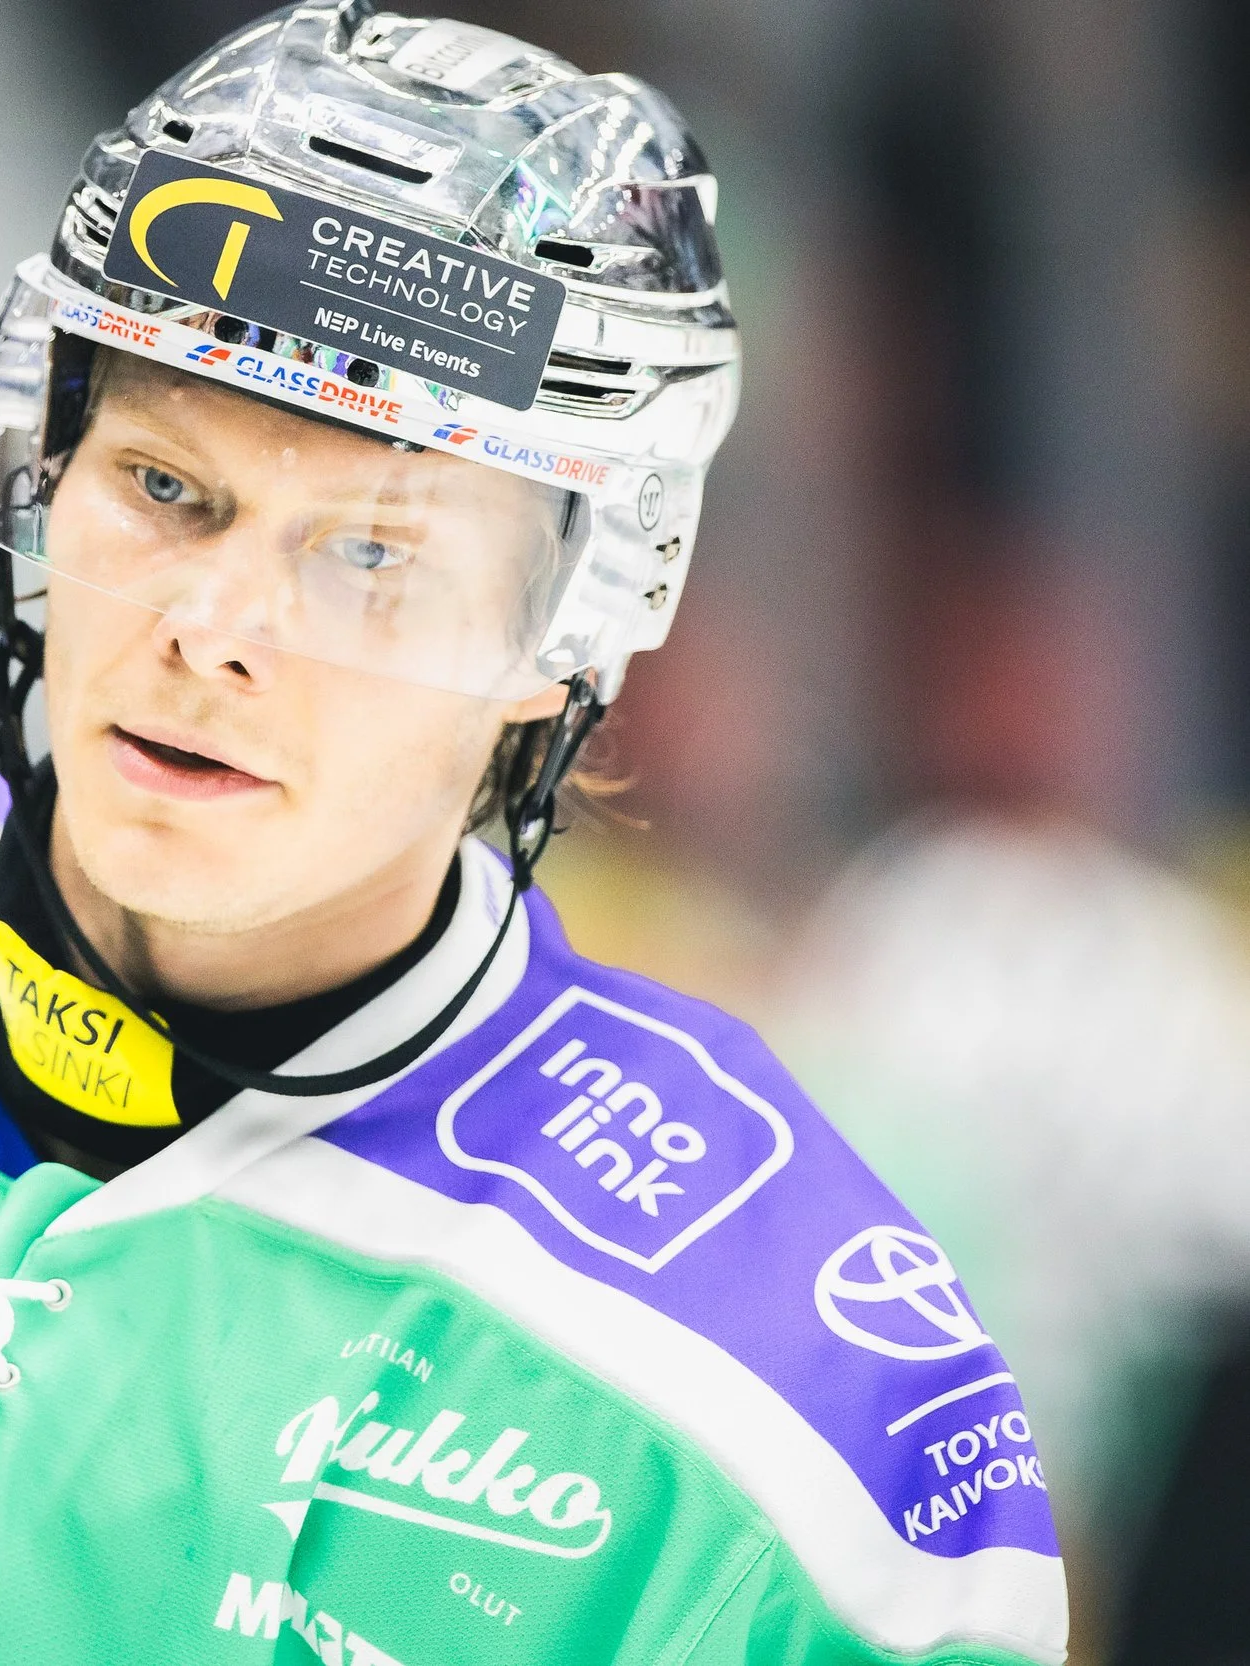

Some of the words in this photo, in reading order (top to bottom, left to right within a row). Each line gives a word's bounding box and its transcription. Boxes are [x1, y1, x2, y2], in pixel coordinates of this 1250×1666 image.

[307, 248, 528, 337] TECHNOLOGY
[312, 216, 536, 312] CREATIVE
[313, 307, 360, 335] NEP
[360, 324, 406, 352] Live
[409, 338, 482, 378] Events
[236, 356, 403, 424] GLASSDRIVE
[483, 435, 611, 485] GLASSDRIVE
[7, 958, 124, 1054] TAKSI
[540, 1094, 687, 1218] link
[903, 1454, 1048, 1542] KAIVOK
[450, 1572, 523, 1627] OLUT
